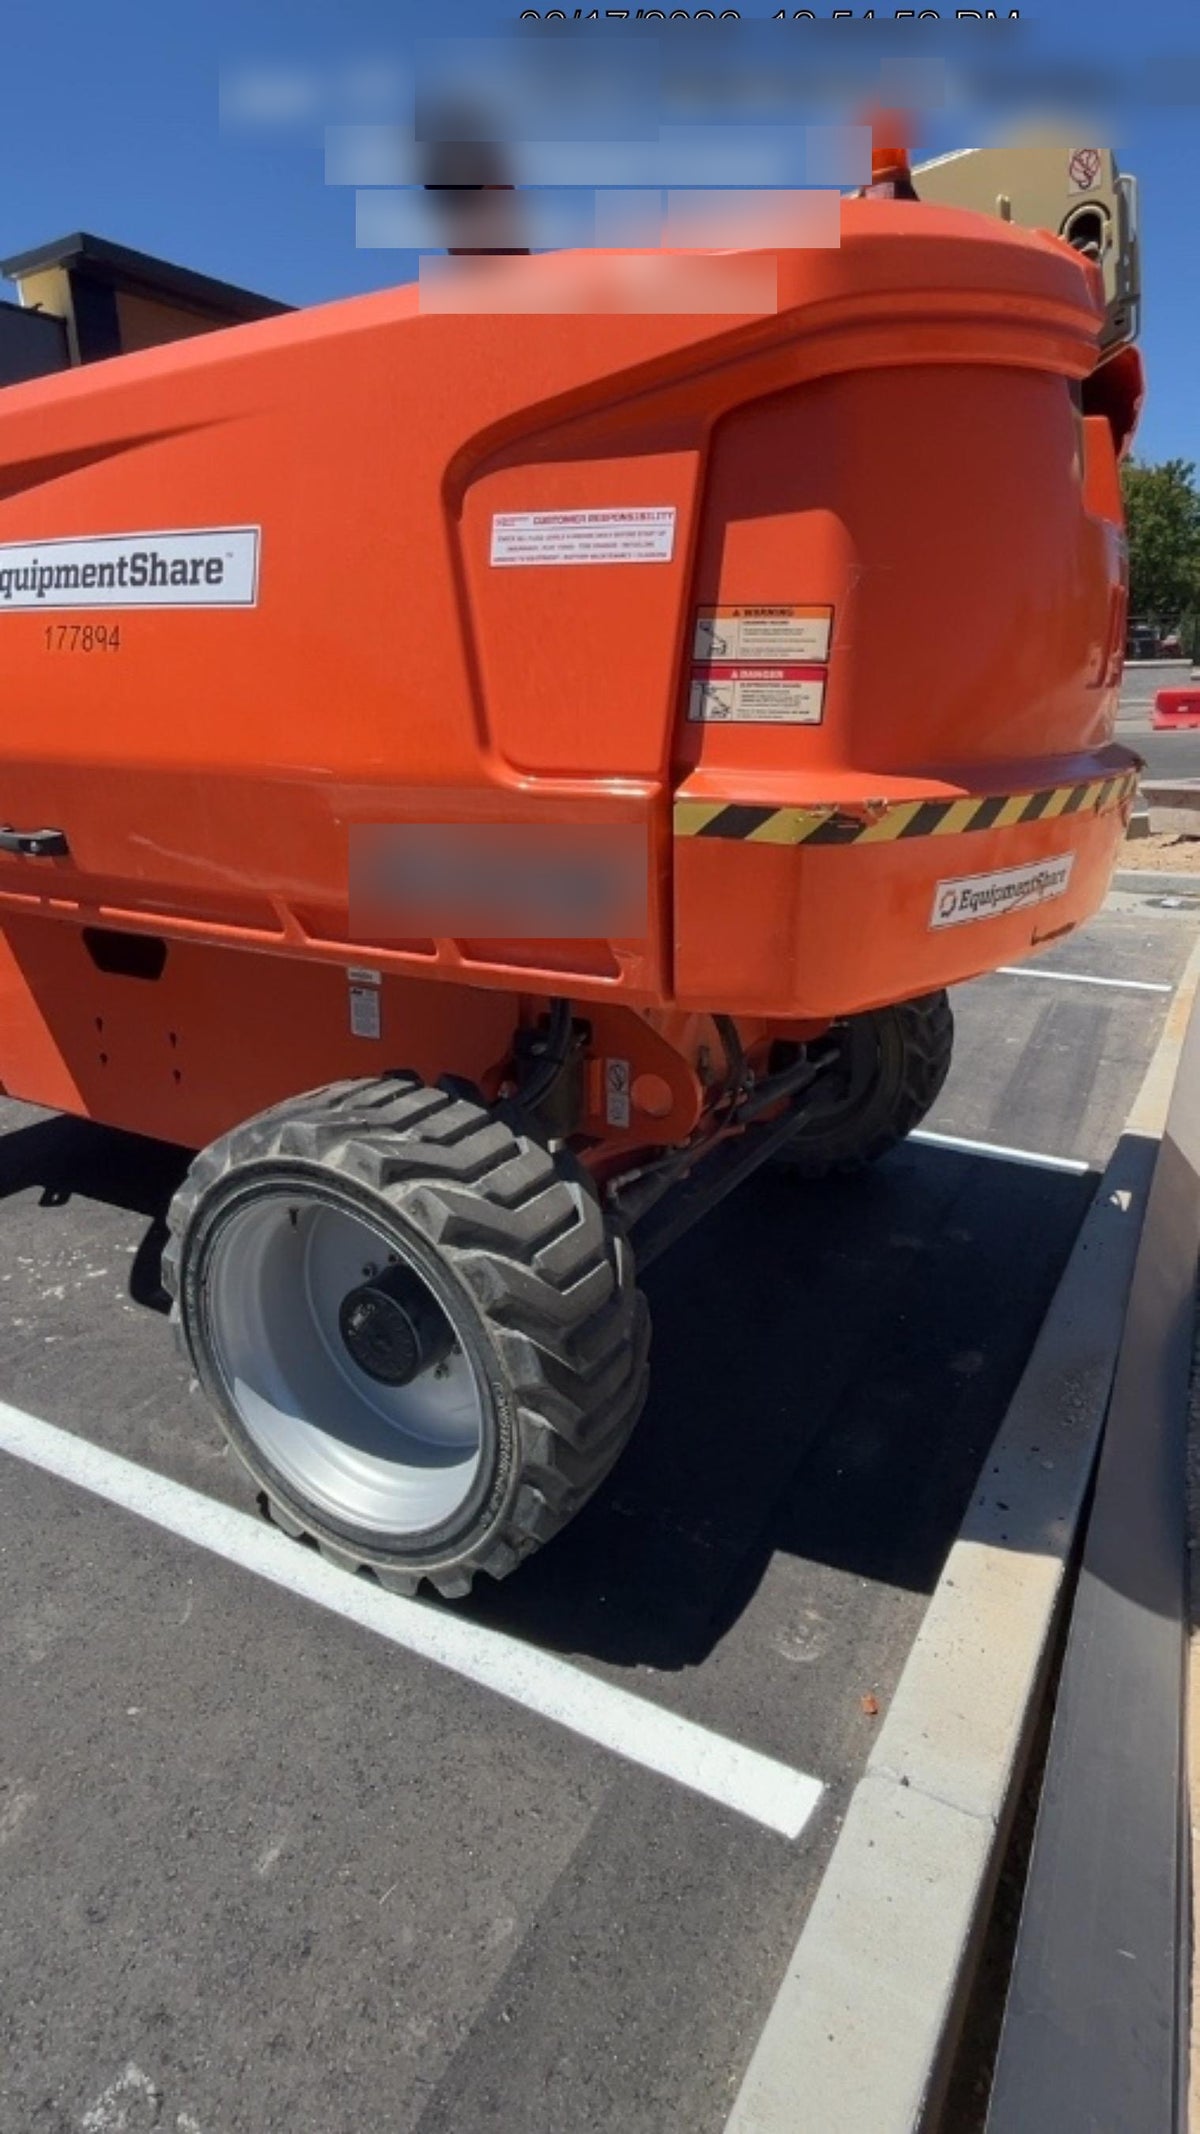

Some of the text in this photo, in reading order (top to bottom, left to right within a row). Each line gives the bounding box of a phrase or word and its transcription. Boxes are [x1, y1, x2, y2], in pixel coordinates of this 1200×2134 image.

[588, 511, 673, 522] RESPONSIBILITY
[744, 608, 794, 617] WARNING
[44, 624, 121, 652] 177894
[739, 670, 784, 679] DANGER
